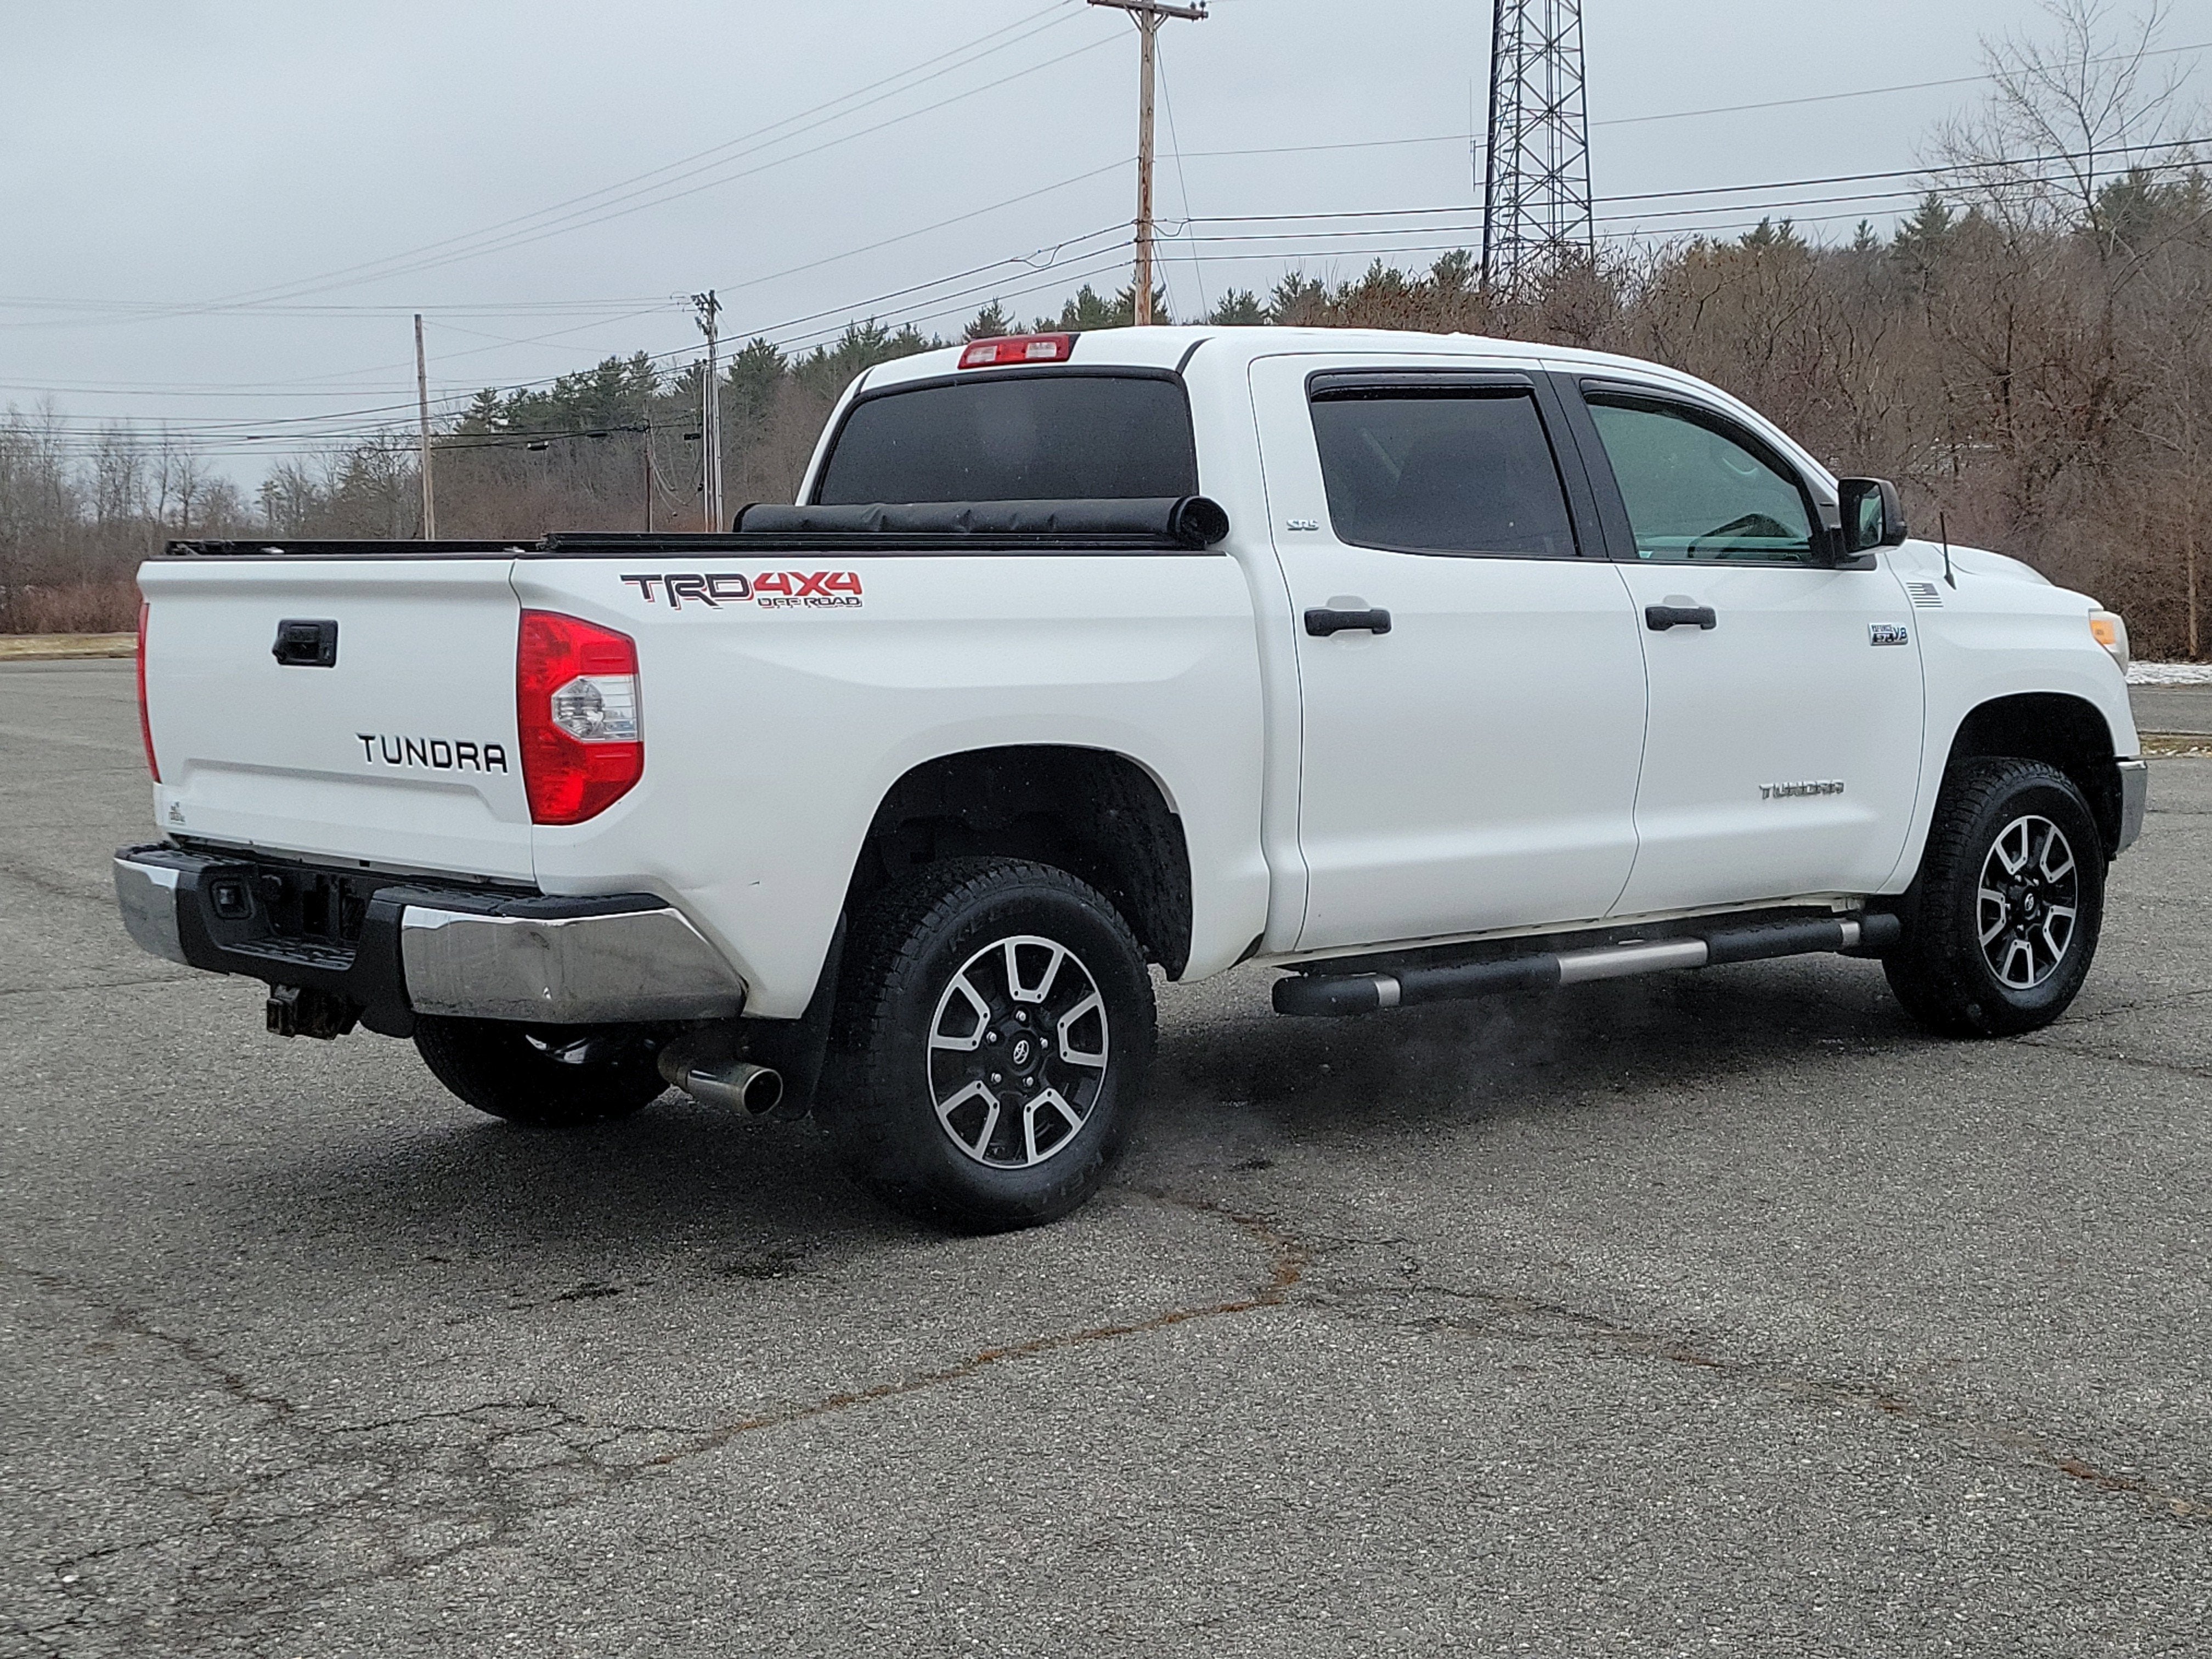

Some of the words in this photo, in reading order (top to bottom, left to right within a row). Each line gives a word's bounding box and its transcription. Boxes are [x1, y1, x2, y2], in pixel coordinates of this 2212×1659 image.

[620, 574, 755, 610] TRD
[757, 597, 802, 608] OFF
[804, 597, 862, 607] ROAD
[356, 732, 508, 773] TUNDRA
[1759, 780, 1844, 799] TUNDRA
